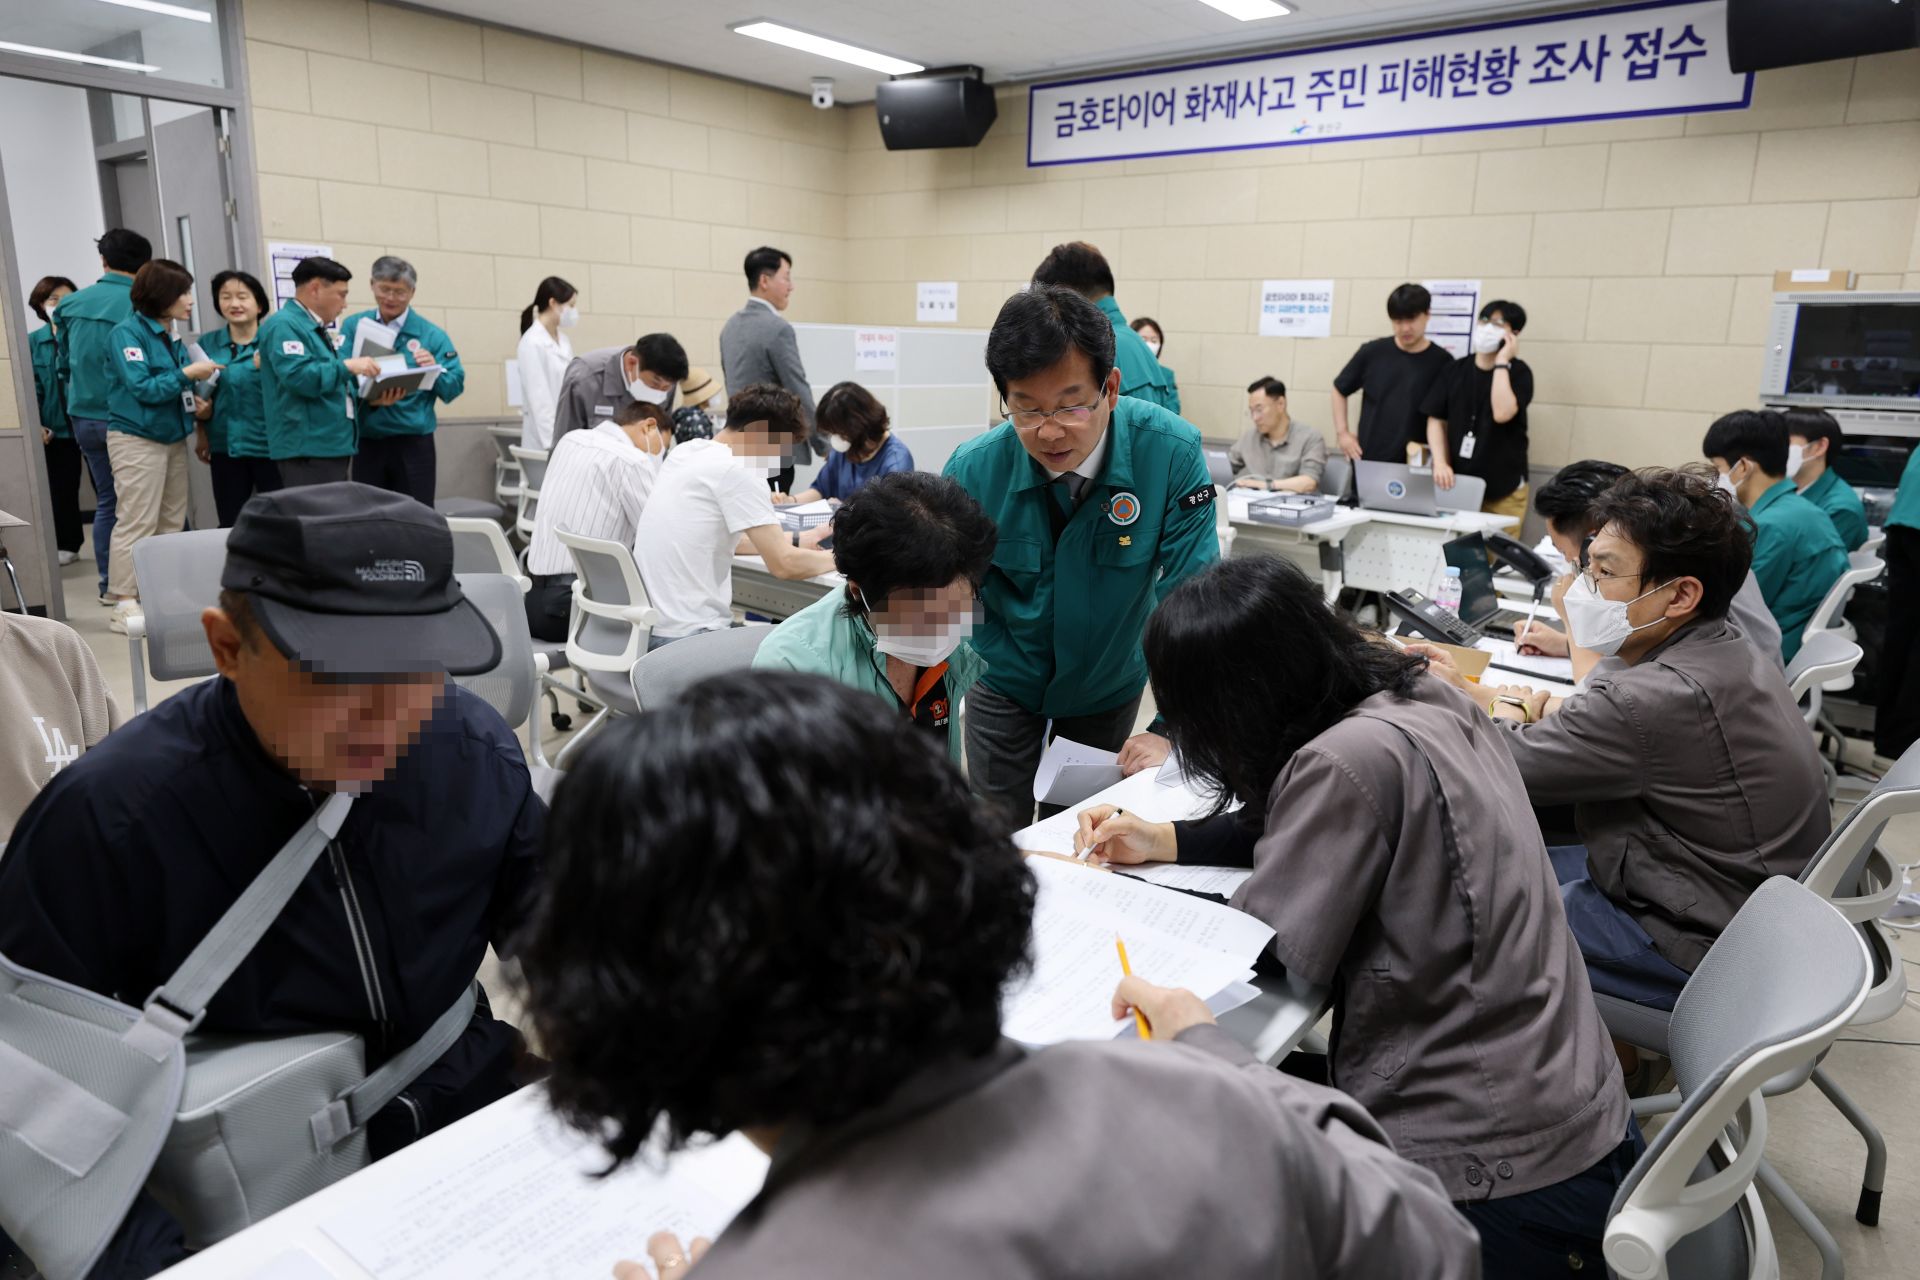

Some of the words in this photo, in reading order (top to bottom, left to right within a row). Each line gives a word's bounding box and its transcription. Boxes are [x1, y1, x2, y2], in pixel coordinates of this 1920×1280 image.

[1054, 87, 1176, 138] 금호타이어
[1184, 76, 1296, 123] 화재사고
[1305, 64, 1368, 112] 주민
[1378, 46, 1520, 102] 피해현황
[1529, 34, 1610, 85] 조사
[1622, 24, 1708, 82] 접수
[1188, 488, 1210, 506] 광산구
[31, 716, 79, 778] LA
